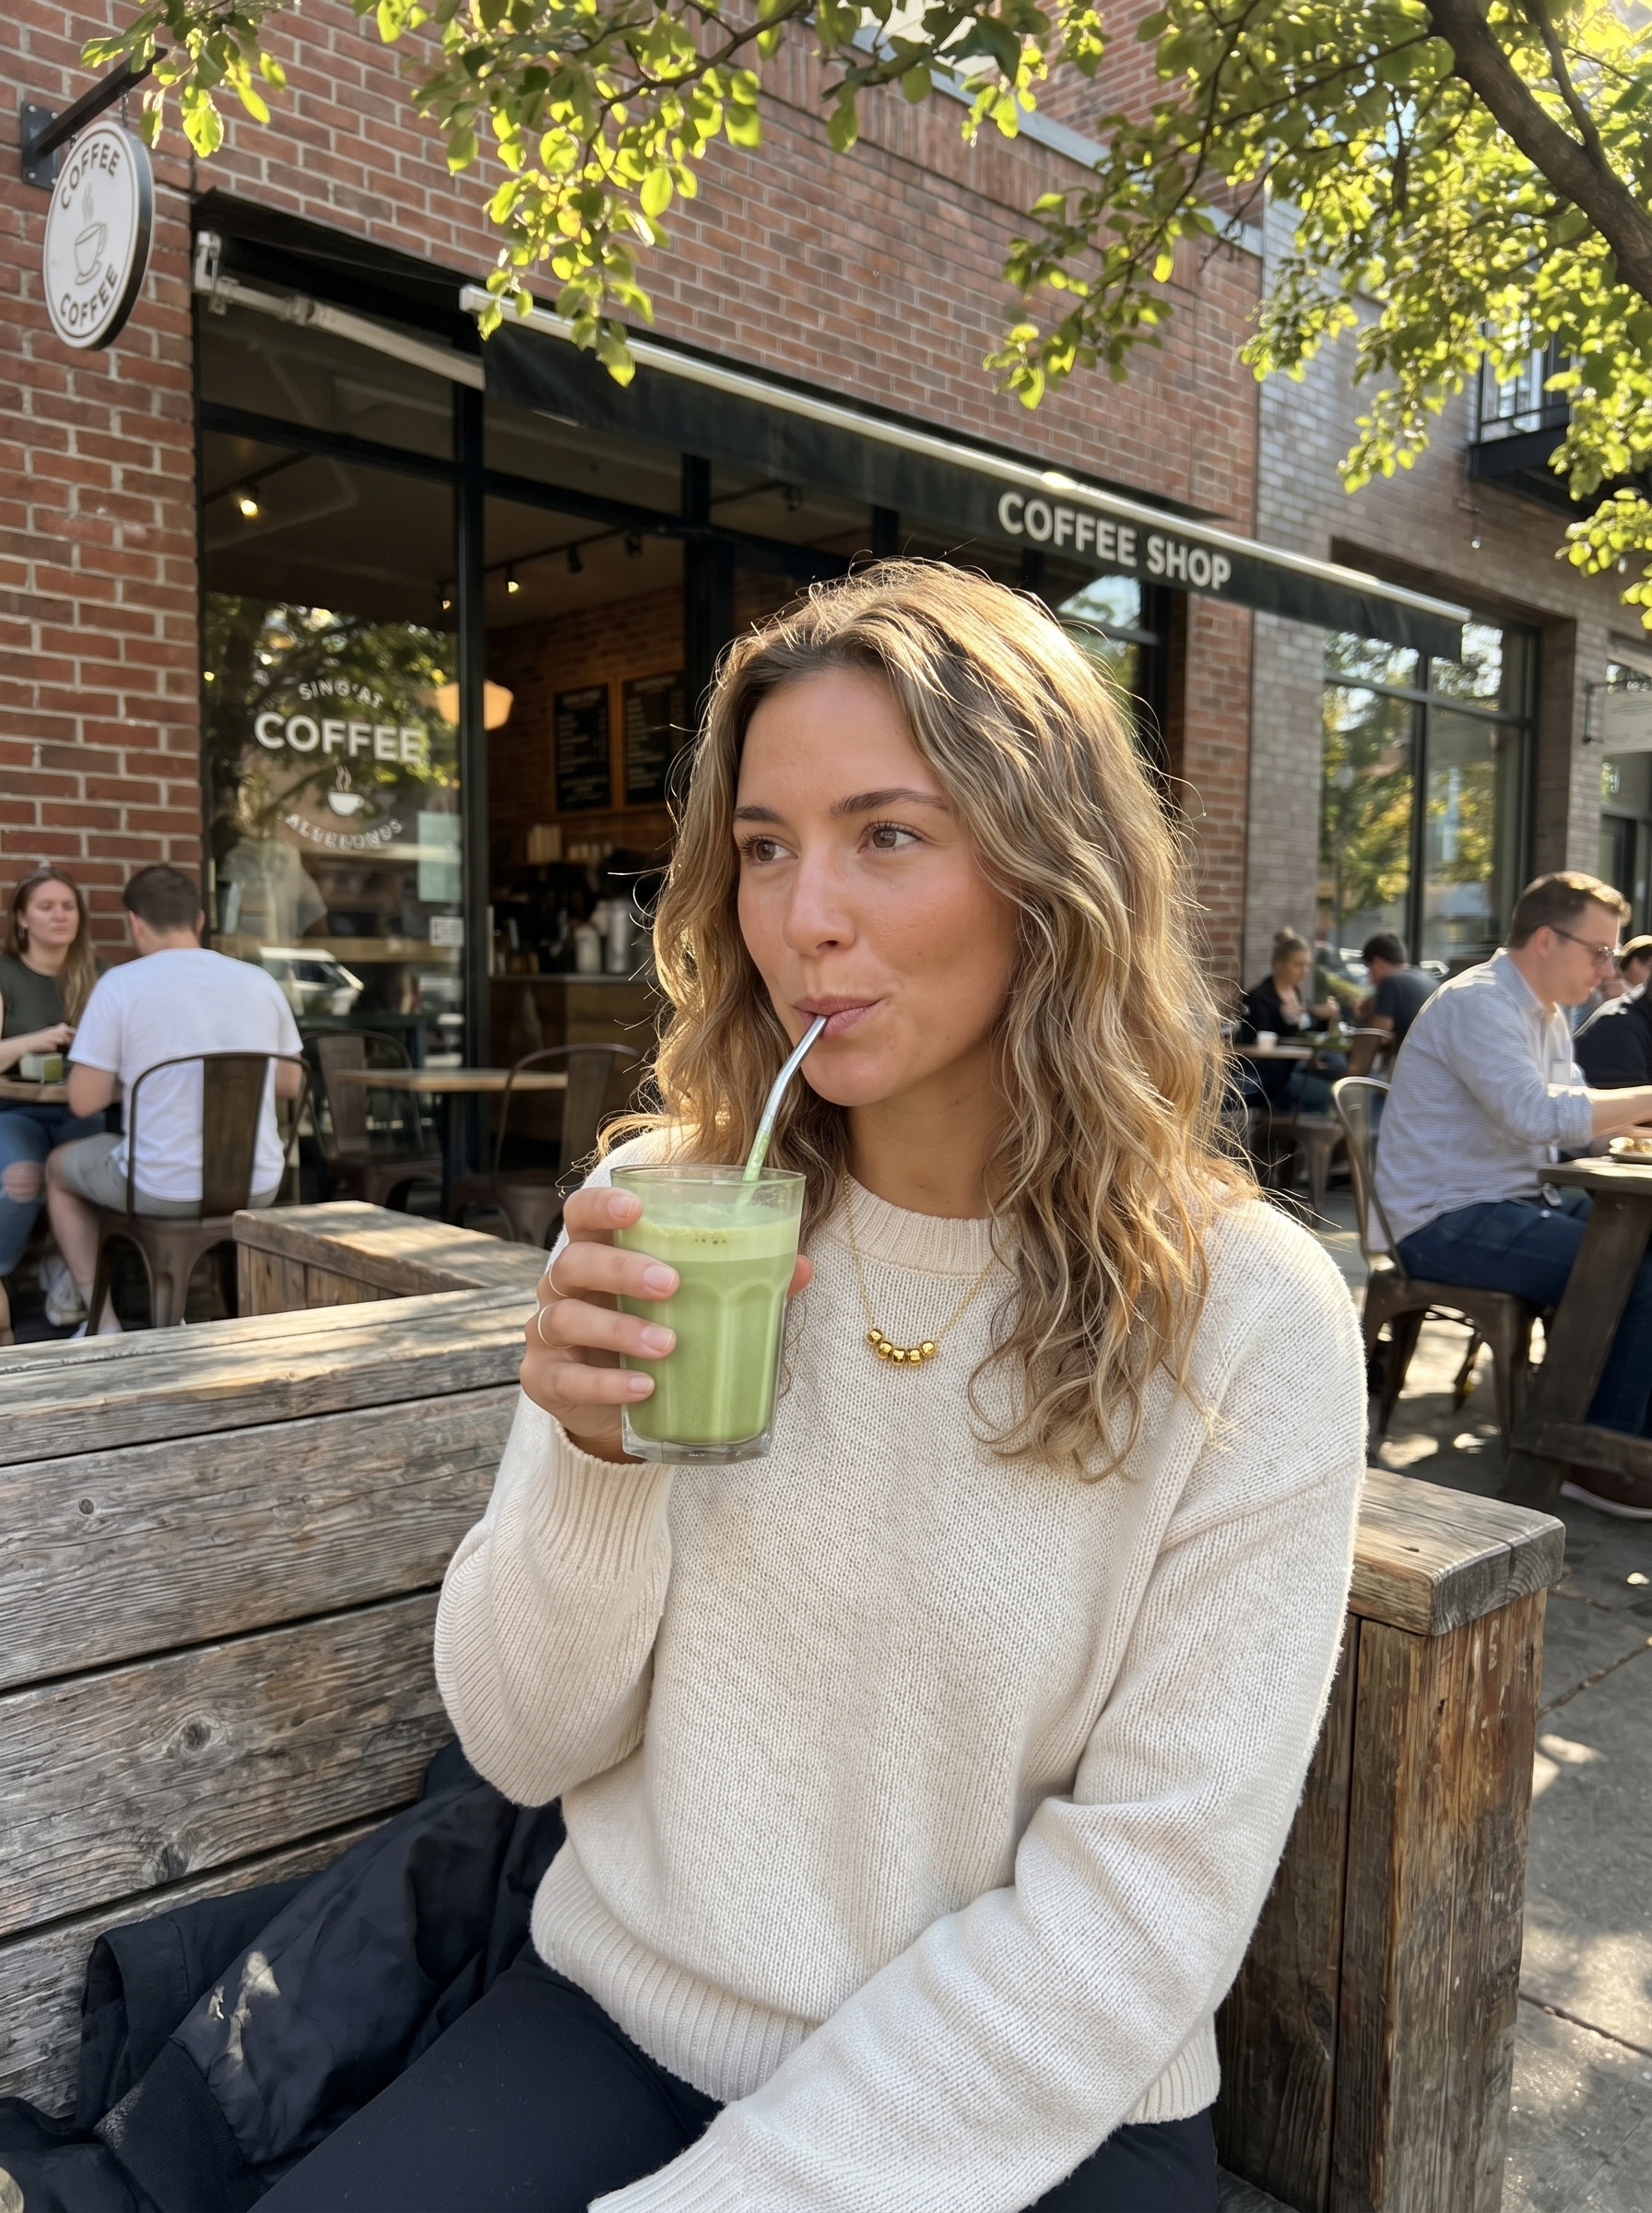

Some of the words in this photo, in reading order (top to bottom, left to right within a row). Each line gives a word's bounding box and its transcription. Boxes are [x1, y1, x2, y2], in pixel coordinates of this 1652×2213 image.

[60, 142, 121, 210] COFFEE
[60, 264, 119, 326] COFFEE
[997, 491, 1138, 568] COFFEE
[1146, 534, 1232, 591] SHOP
[254, 711, 423, 763] COFFEE
